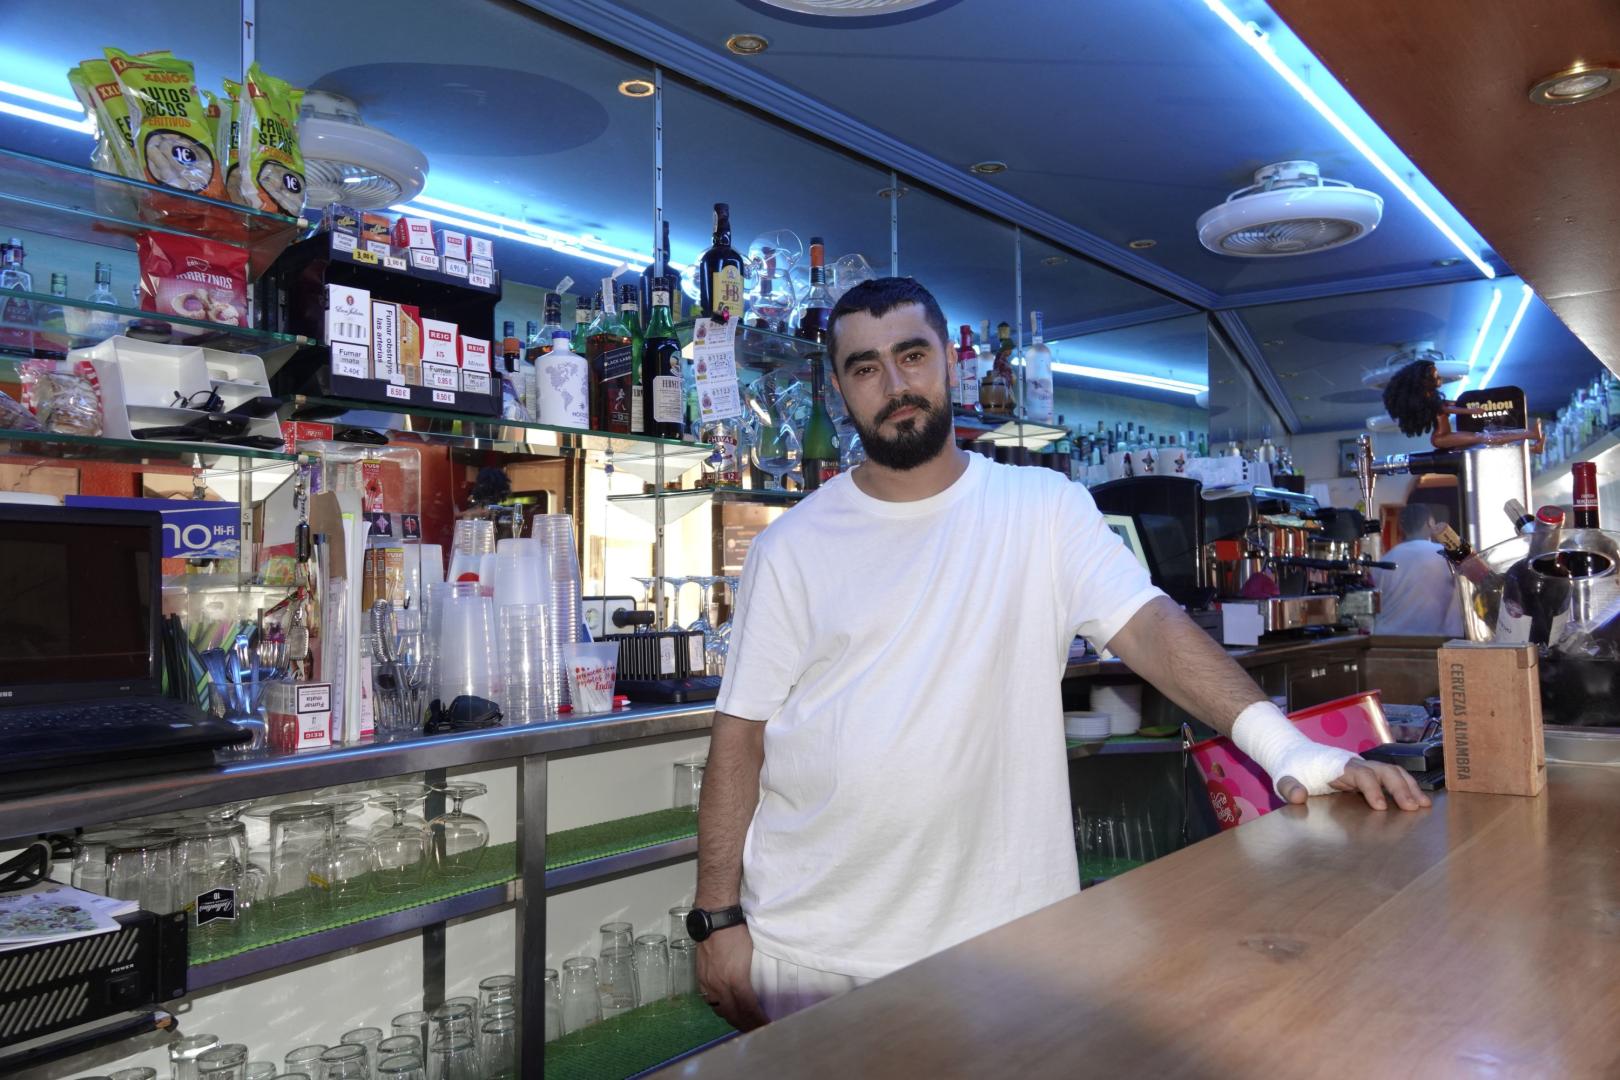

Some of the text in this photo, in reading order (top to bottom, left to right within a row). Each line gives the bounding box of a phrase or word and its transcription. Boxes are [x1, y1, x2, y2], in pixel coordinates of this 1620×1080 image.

[430, 332, 450, 340] REIG
[339, 348, 361, 357] Fumar
[213, 525, 235, 536] Hi-Fi
[1450, 662, 1471, 781] CERVEZAS ALHAMBRA
[213, 892, 220, 900] 10
[111, 963, 135, 973] POWER
